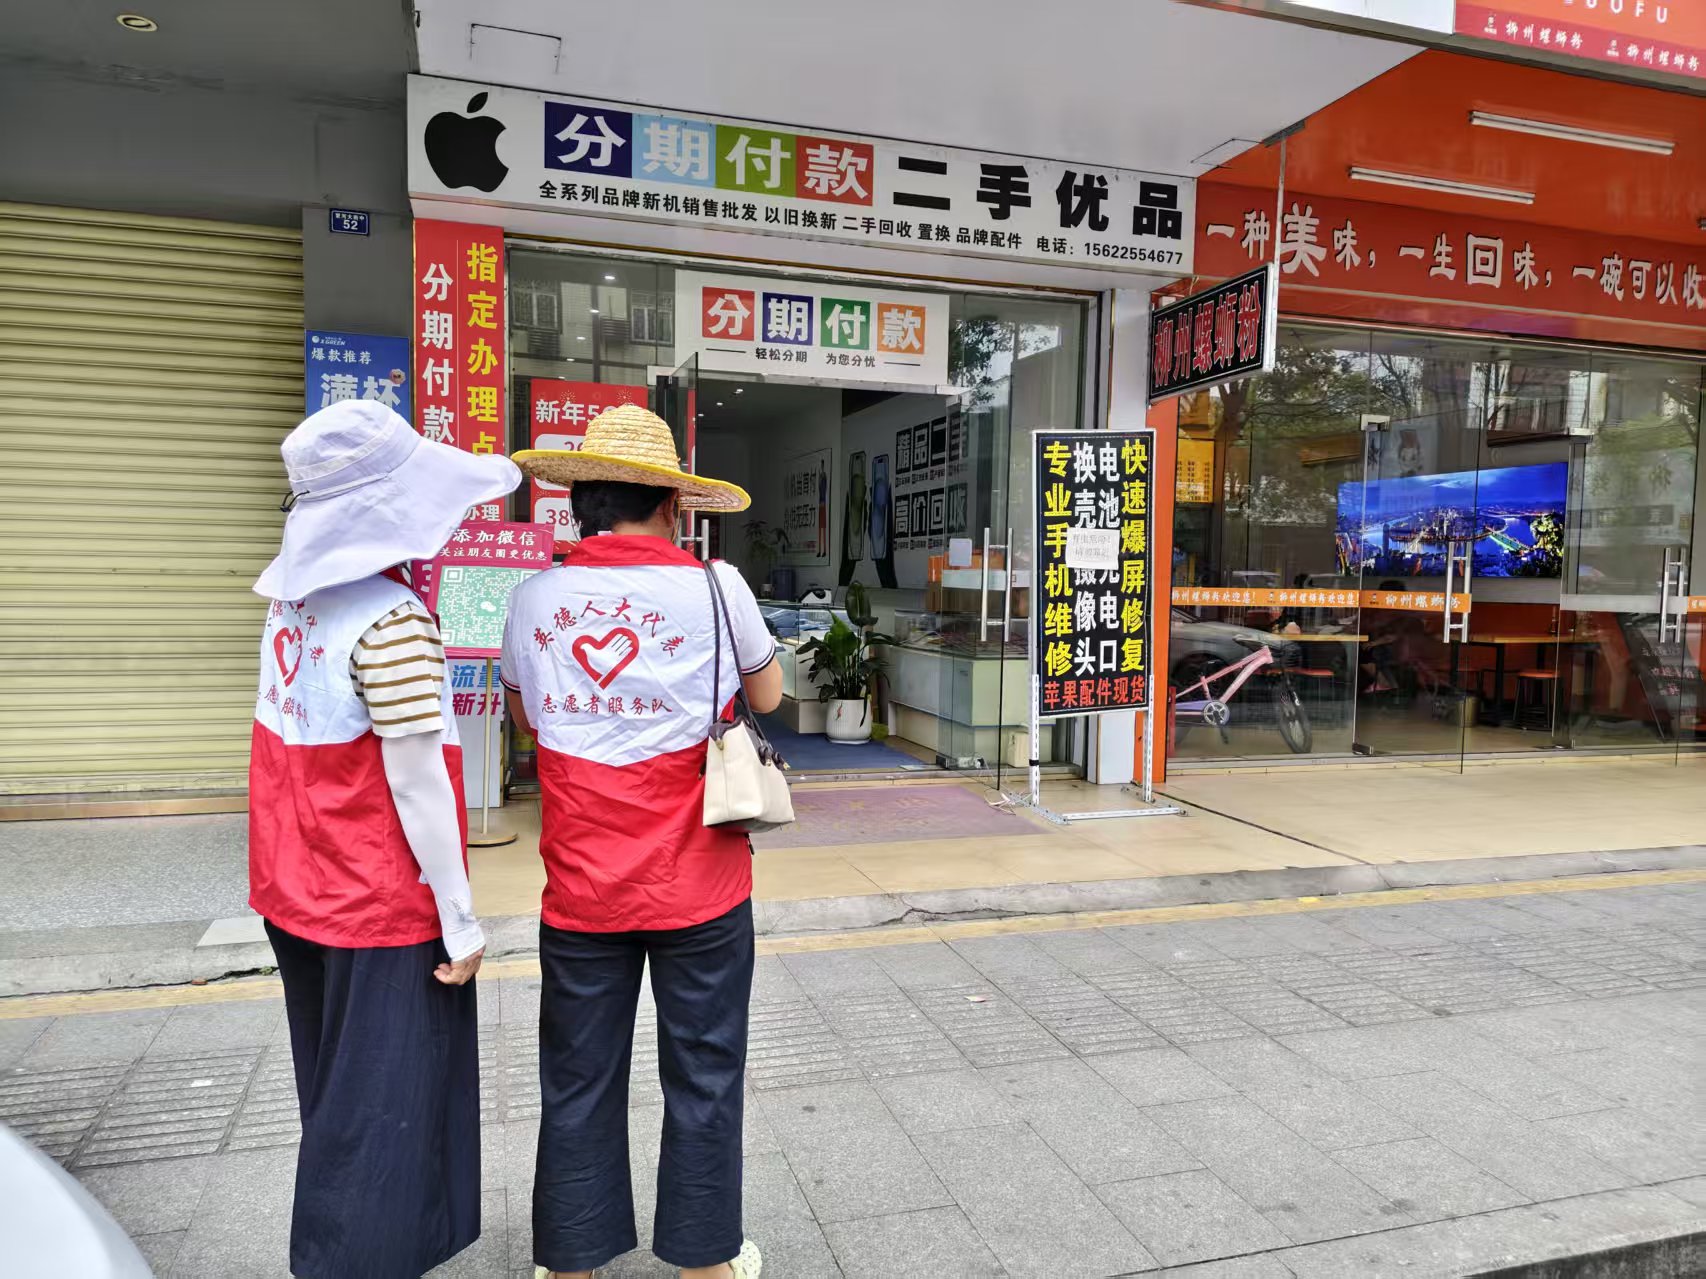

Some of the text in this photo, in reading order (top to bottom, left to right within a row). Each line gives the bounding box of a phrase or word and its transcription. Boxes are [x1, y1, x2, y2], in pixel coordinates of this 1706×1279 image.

[554, 112, 1183, 240] 分期付款 二手优品
[343, 219, 358, 230] 52
[1084, 242, 1183, 265] 15622554677
[707, 293, 921, 351] 分期付款
[311, 347, 372, 365] 爆款推荐
[421, 262, 455, 444] 分期付款
[755, 347, 876, 368] 轻松分期 为您分忧
[452, 528, 537, 546] 添加微信
[1043, 441, 1073, 677] 专业手机维修
[1121, 439, 1148, 672] 快速爆屏修复
[533, 597, 684, 657] 英德人大代表
[541, 693, 673, 714] 志愿者服务队
[1044, 675, 1145, 709] 苹果配件现货
